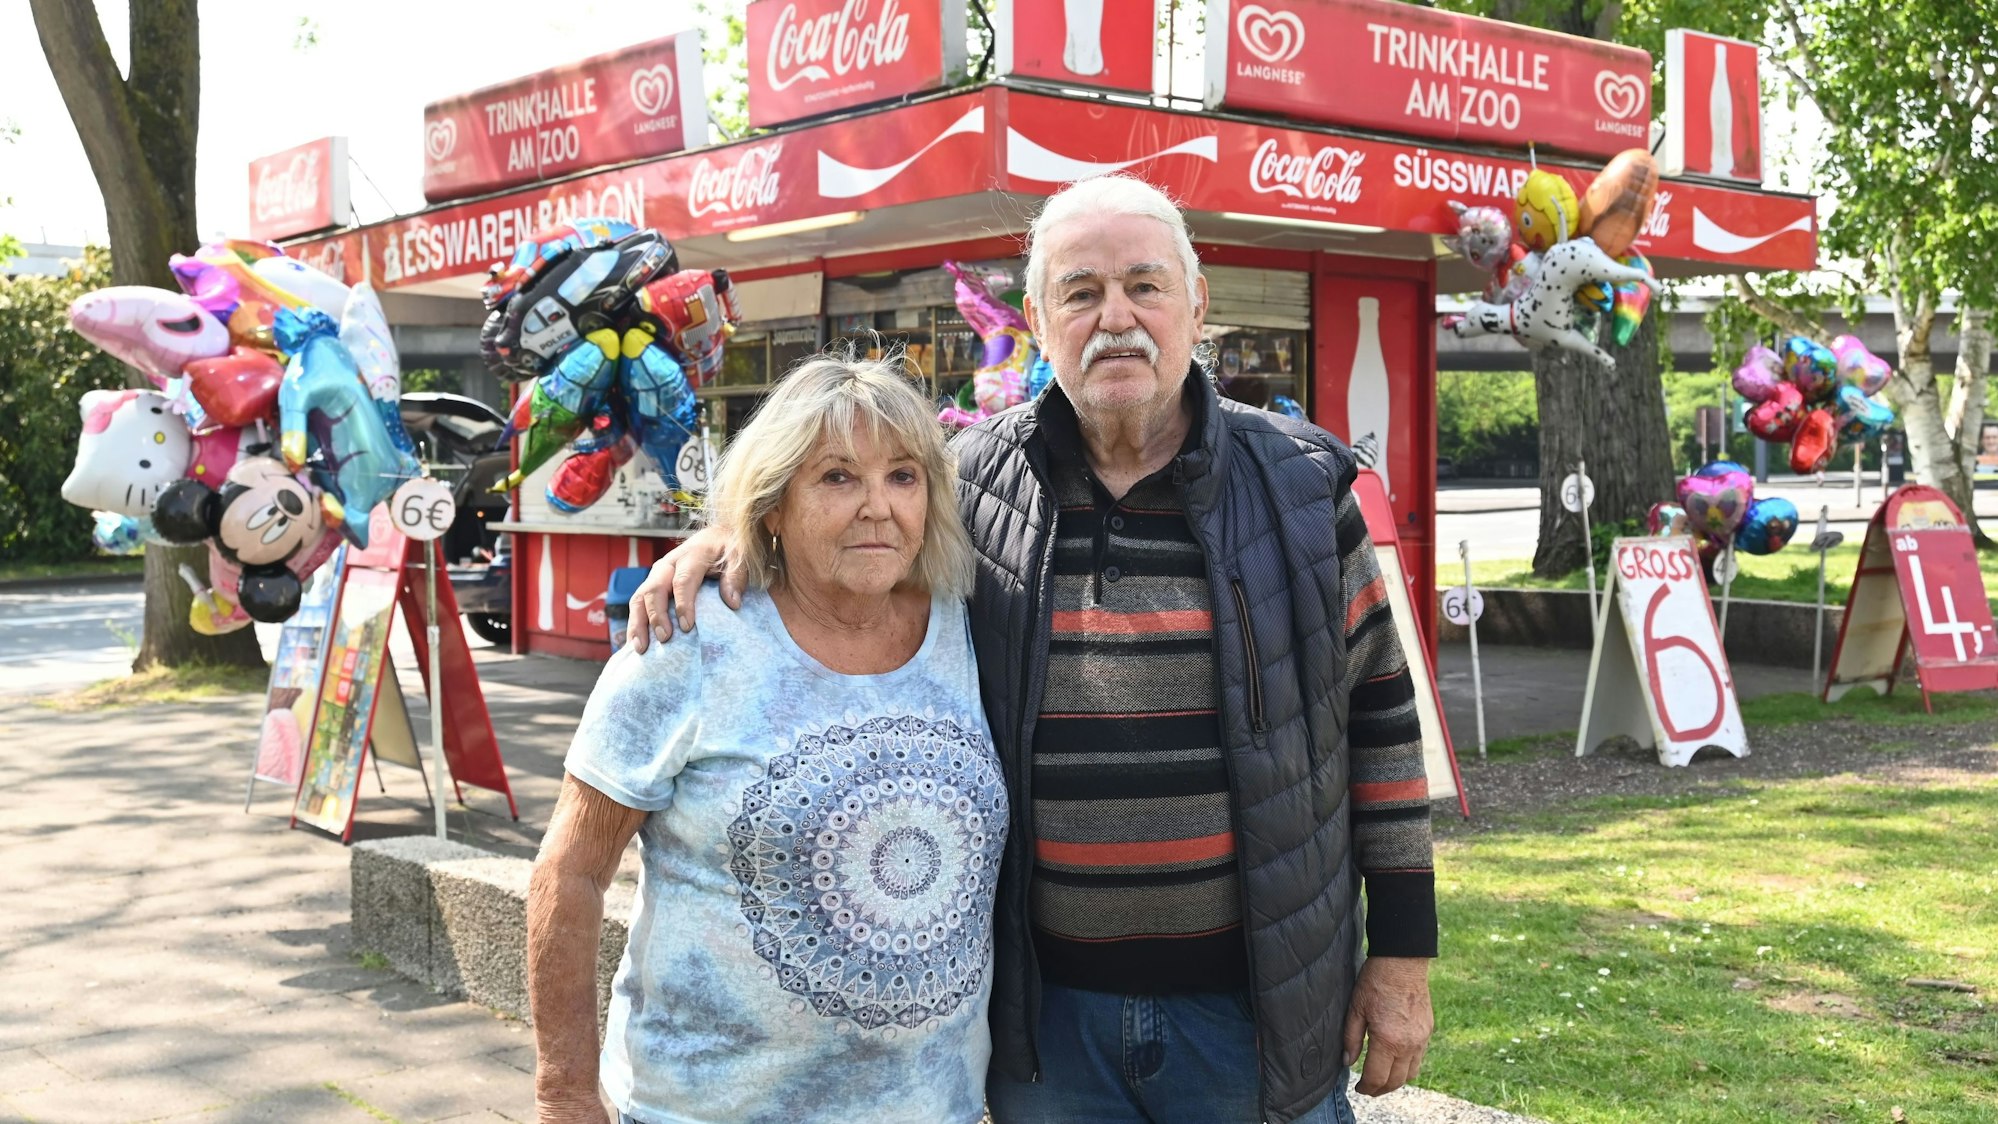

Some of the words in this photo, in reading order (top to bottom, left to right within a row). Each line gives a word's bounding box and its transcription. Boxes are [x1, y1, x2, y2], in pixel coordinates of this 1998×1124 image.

[767, 0, 910, 91] Coca-Cola
[1367, 23, 1549, 91] TRINKHALLE
[1237, 62, 1303, 85] LANGNESE
[485, 78, 597, 136] TRINKHALLE
[634, 116, 677, 135] LANGNESE
[1404, 77, 1451, 121] AM
[1460, 85, 1520, 130] ZOO
[507, 137, 535, 172] AM
[540, 125, 580, 165] ZOO
[1595, 118, 1643, 137] LANGNESE
[688, 143, 783, 218] Coca-Cola
[1249, 138, 1366, 203] Coca-Cola
[540, 329, 573, 350] POLICE
[401, 494, 451, 531] 6€
[1618, 546, 1697, 581] GROSS
[1896, 535, 1919, 551] ab
[1644, 583, 1725, 742] 6
